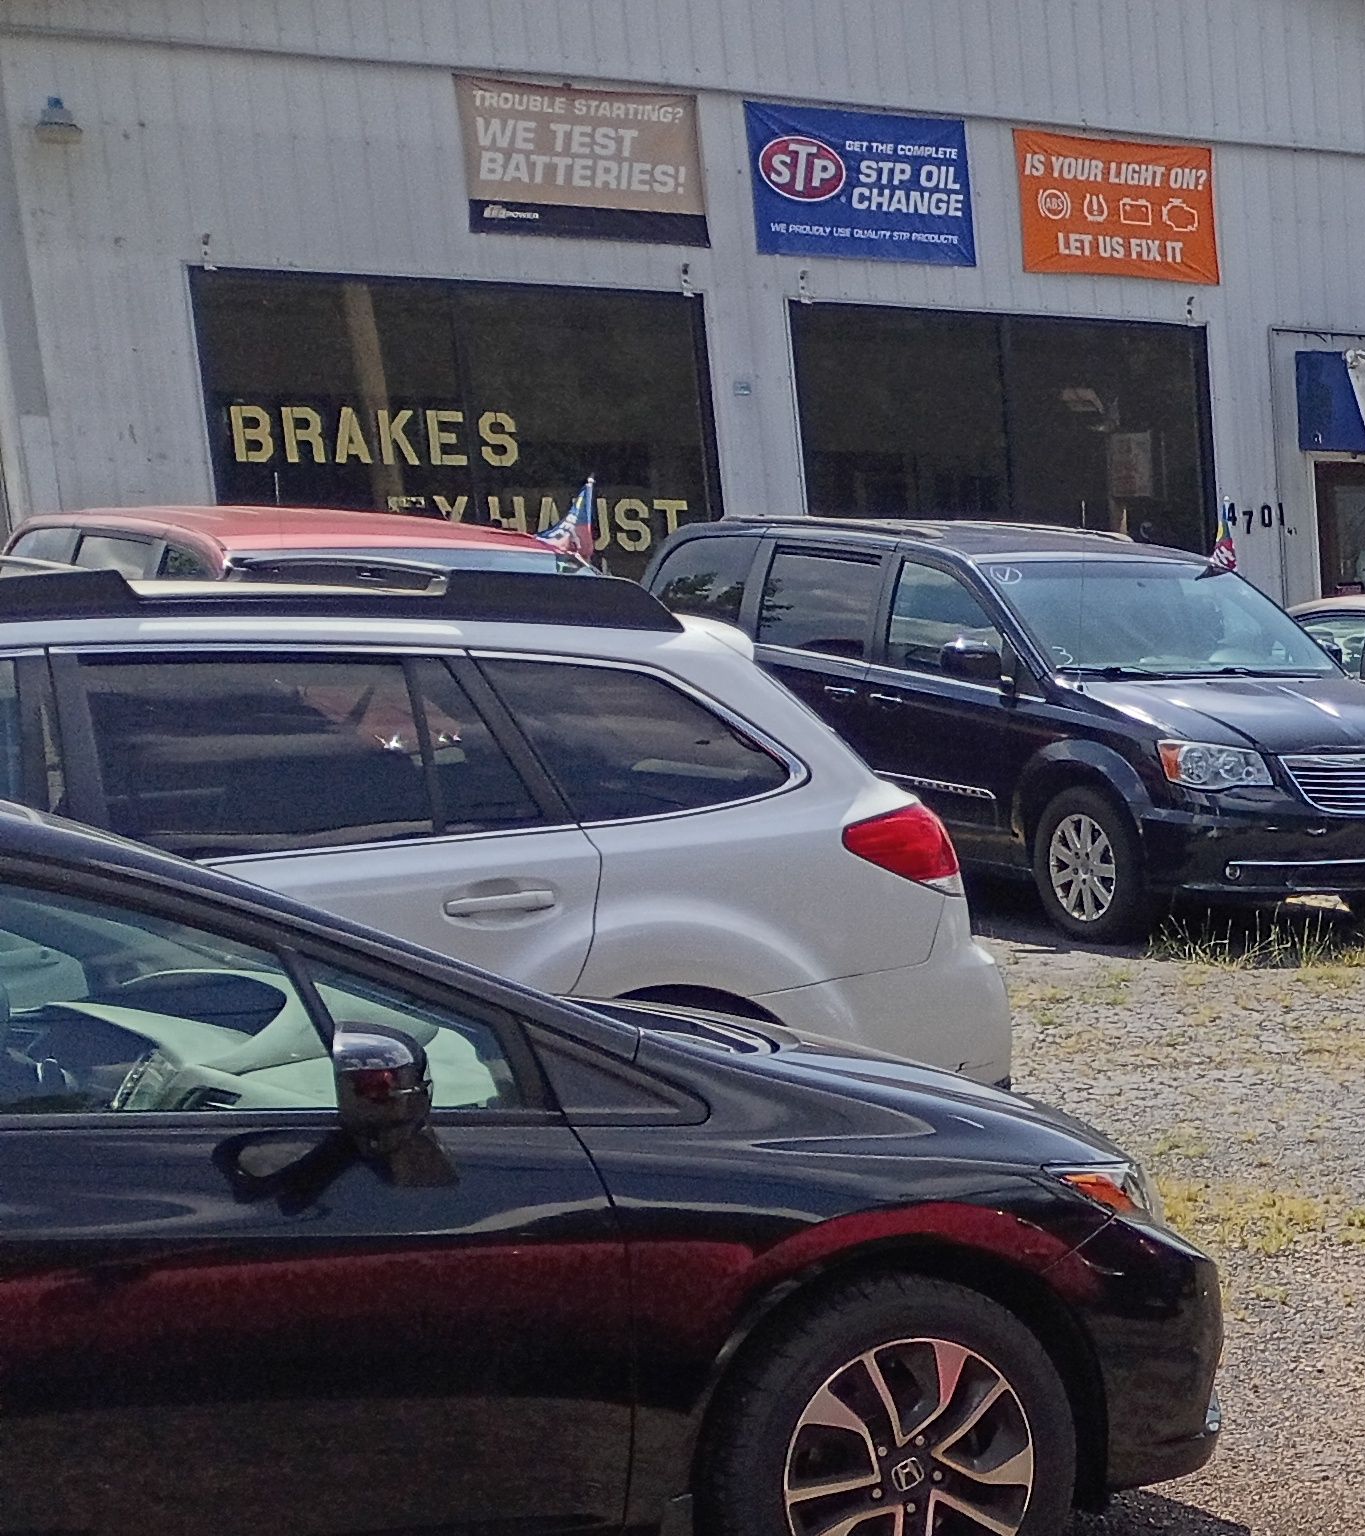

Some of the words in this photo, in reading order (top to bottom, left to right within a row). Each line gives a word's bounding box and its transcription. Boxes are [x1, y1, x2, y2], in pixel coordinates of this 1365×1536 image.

[472, 90, 566, 114] TROUBLE
[574, 99, 684, 123] STARTING?
[475, 116, 537, 150] WE
[550, 123, 639, 157] TEST
[845, 140, 870, 152] GET
[870, 142, 894, 154] THE
[897, 145, 958, 160] COMPLETE
[479, 150, 686, 194] BATTERIES!
[770, 143, 836, 191] STP
[858, 160, 912, 185] STP
[919, 164, 960, 190] OIL
[1024, 153, 1045, 177] IS
[1051, 156, 1104, 183] YOUR
[1108, 162, 1166, 187] LIGHT
[1169, 168, 1208, 191] ON?
[851, 187, 964, 217] CHANGE
[1045, 197, 1064, 210] ABS
[770, 222, 787, 233] WE
[788, 224, 832, 237] PROUDLY
[833, 227, 851, 237] USE
[853, 229, 892, 240] QUALITY
[892, 231, 911, 241] STP
[911, 232, 960, 244] PRODUCTS
[1057, 232, 1093, 256] LET
[1098, 235, 1125, 259] US
[1130, 238, 1162, 262] FIX
[1165, 240, 1183, 263] IT
[229, 405, 520, 467] BRAKES
[1227, 502, 1285, 534] 4701
